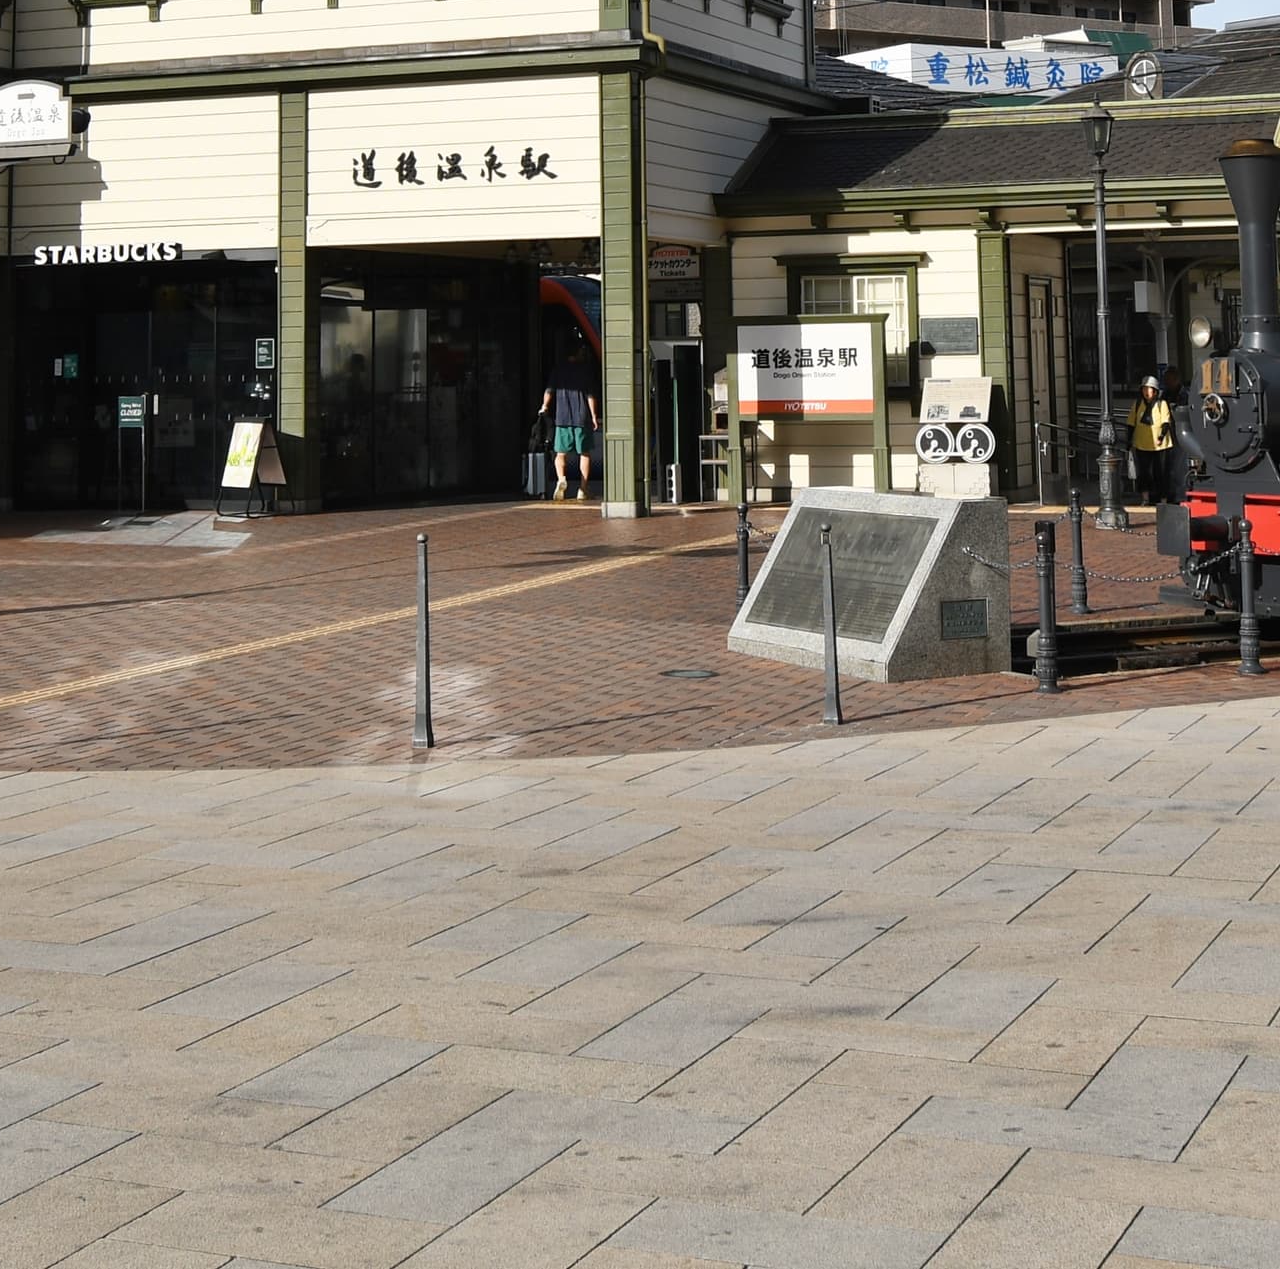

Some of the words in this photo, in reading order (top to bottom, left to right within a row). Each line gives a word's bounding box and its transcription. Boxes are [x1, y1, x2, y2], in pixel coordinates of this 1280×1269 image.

[926, 51, 1105, 92] 重松鍼灸院
[352, 145, 559, 189] 道後温泉駅
[34, 242, 178, 266] STARBUCKS
[751, 348, 858, 370] 道後温泉駅
[773, 372, 791, 380] Dogo
[1200, 358, 1233, 394] 14
[784, 401, 827, 412] IYOTETSU
